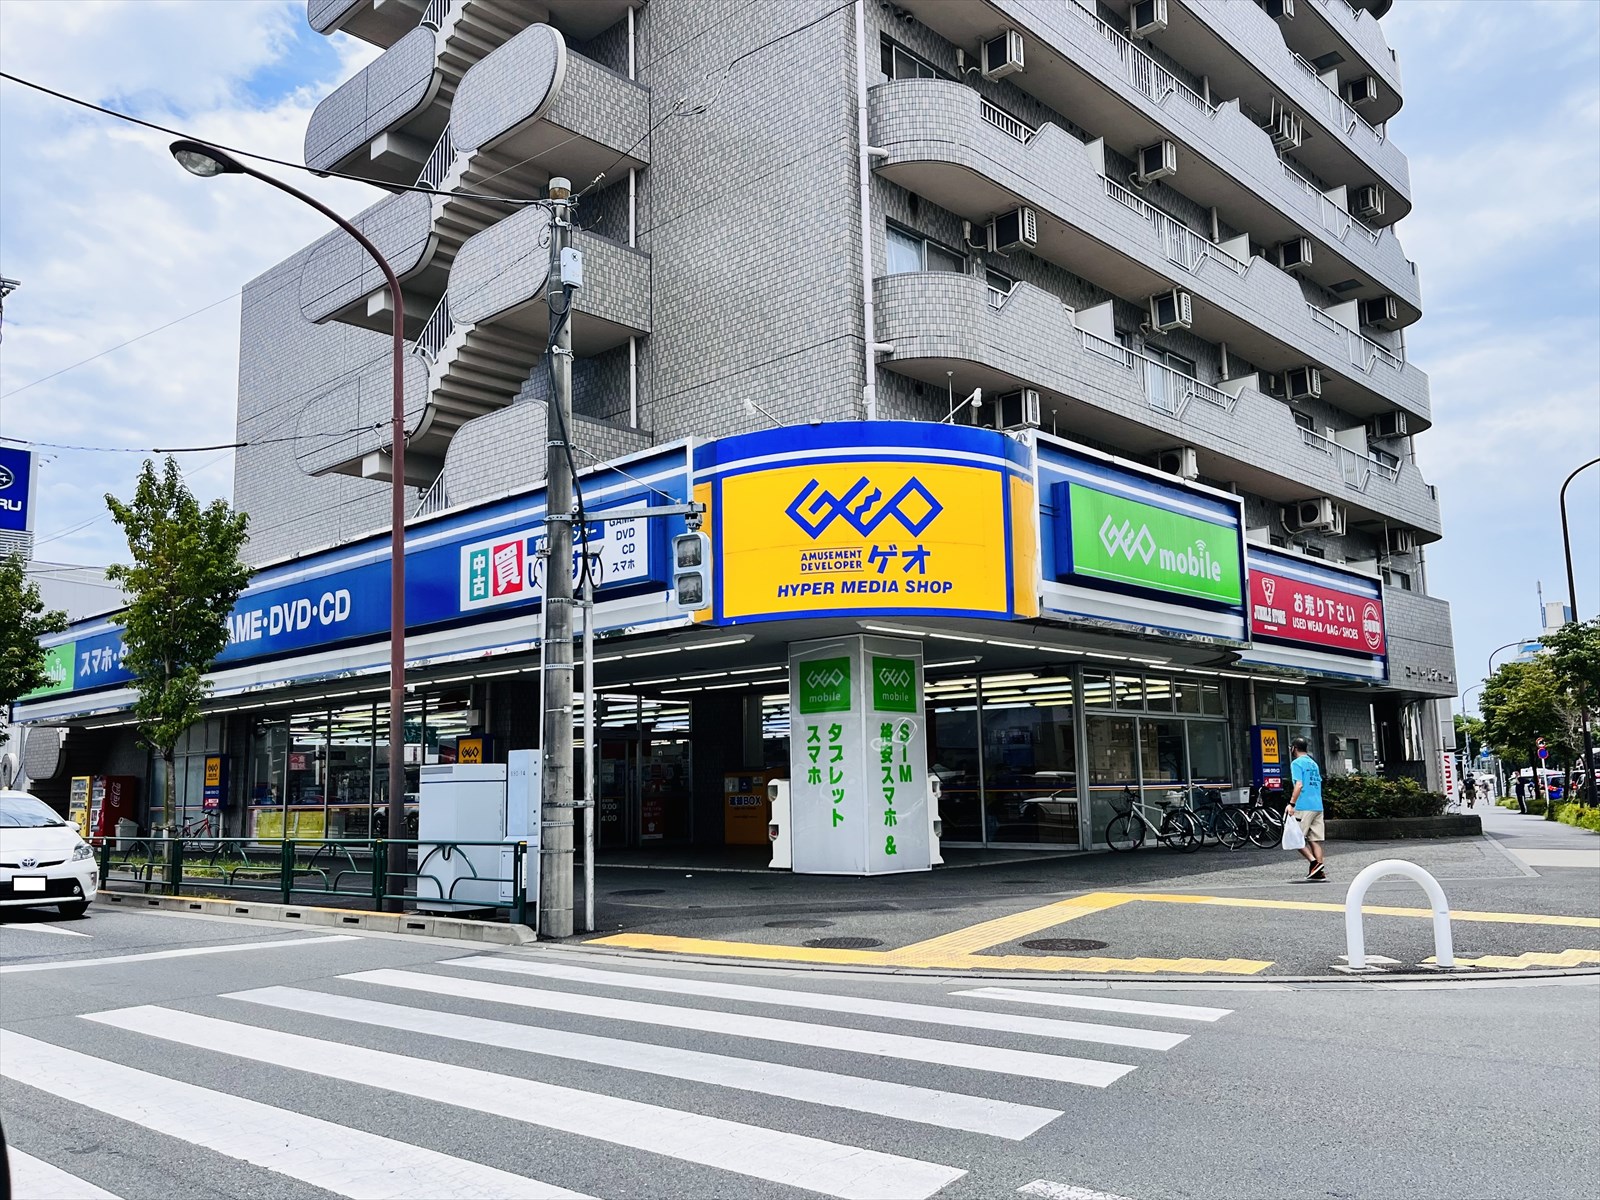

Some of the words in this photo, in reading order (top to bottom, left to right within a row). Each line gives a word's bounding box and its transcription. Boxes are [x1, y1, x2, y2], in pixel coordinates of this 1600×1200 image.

[785, 475, 944, 540] GEO
[616, 527, 635, 541] DVD
[622, 543, 635, 555] CD
[801, 550, 862, 562] AMUSEMENT
[1099, 514, 1156, 566] GEO
[1160, 546, 1221, 582] mobile
[612, 559, 635, 573] スマホ
[801, 560, 863, 572] DEVELOPER
[868, 544, 931, 574] ゲオ
[473, 554, 486, 596] 中古
[777, 581, 835, 598] HYPER
[841, 580, 899, 595] MEDIA
[905, 580, 953, 594] SHOP
[1293, 592, 1356, 624] お売り下さい
[1292, 616, 1307, 630] USED
[806, 668, 844, 688] GEO
[879, 667, 911, 687] GEO
[809, 692, 841, 704] mobile
[882, 691, 909, 702] mobile
[806, 725, 822, 785] スマホ
[899, 723, 912, 783] SIM
